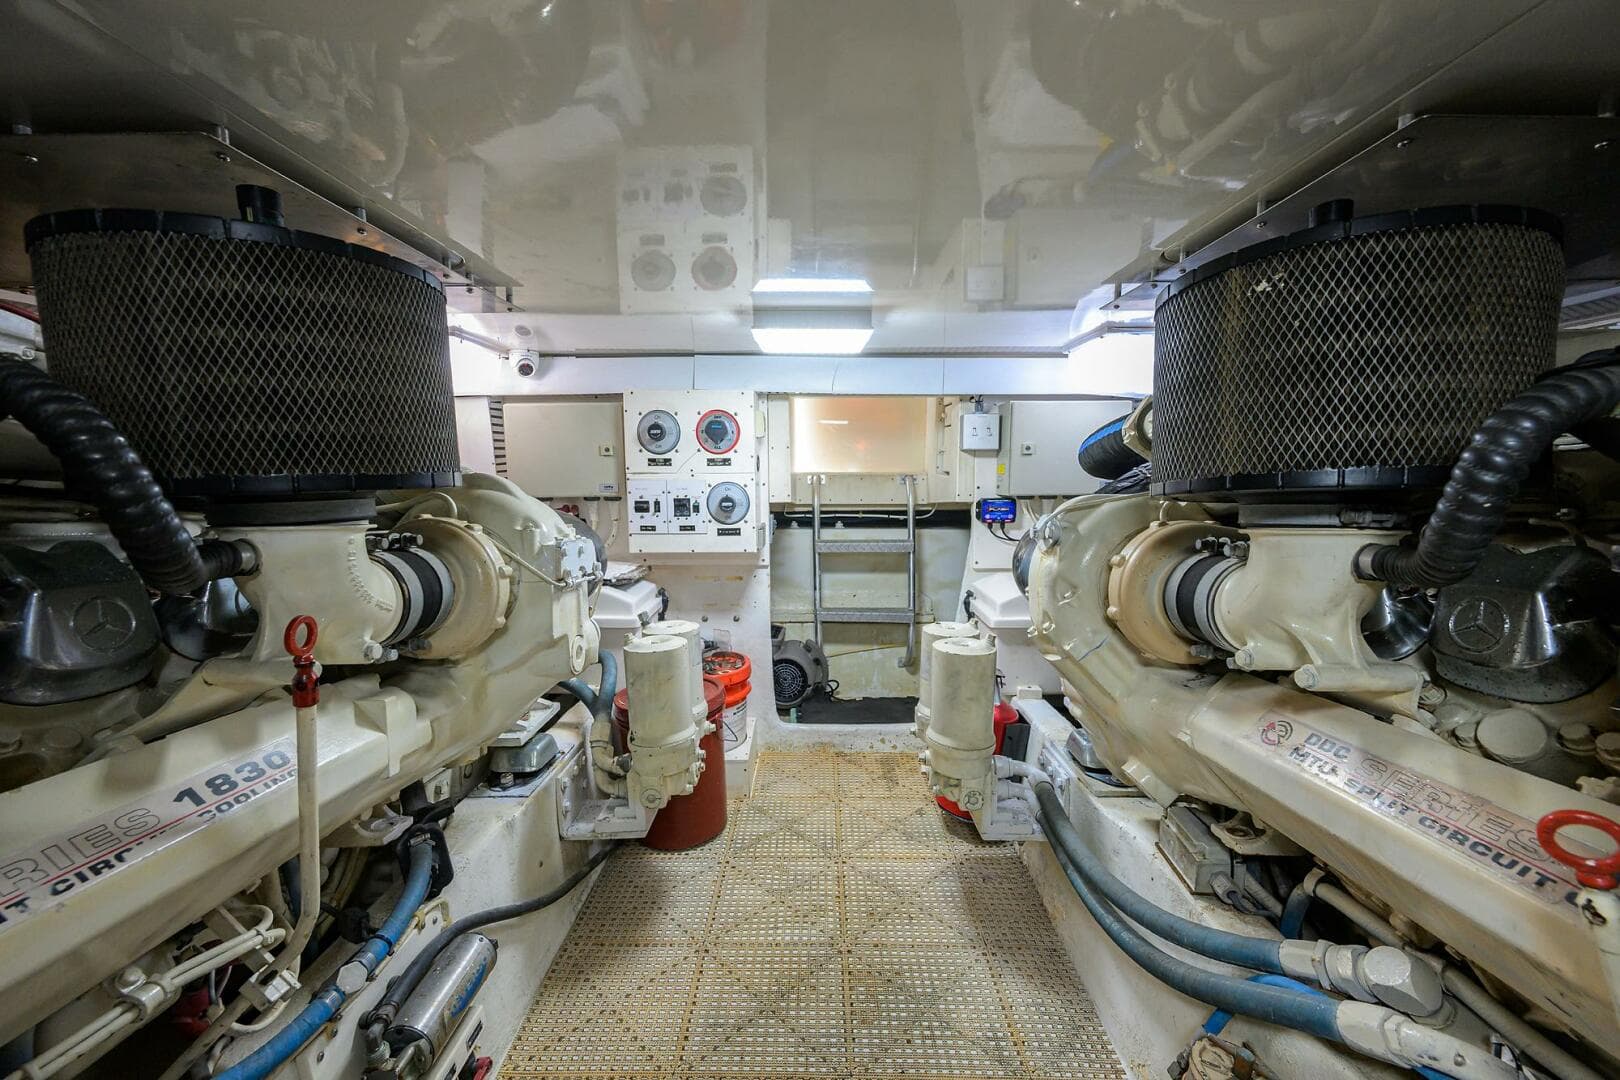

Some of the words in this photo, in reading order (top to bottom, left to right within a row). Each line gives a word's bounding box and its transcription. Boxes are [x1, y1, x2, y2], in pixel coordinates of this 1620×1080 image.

[1304, 733, 1351, 759] DDC
[173, 750, 290, 807] 1830
[1418, 816, 1557, 887] CIRCUIT
